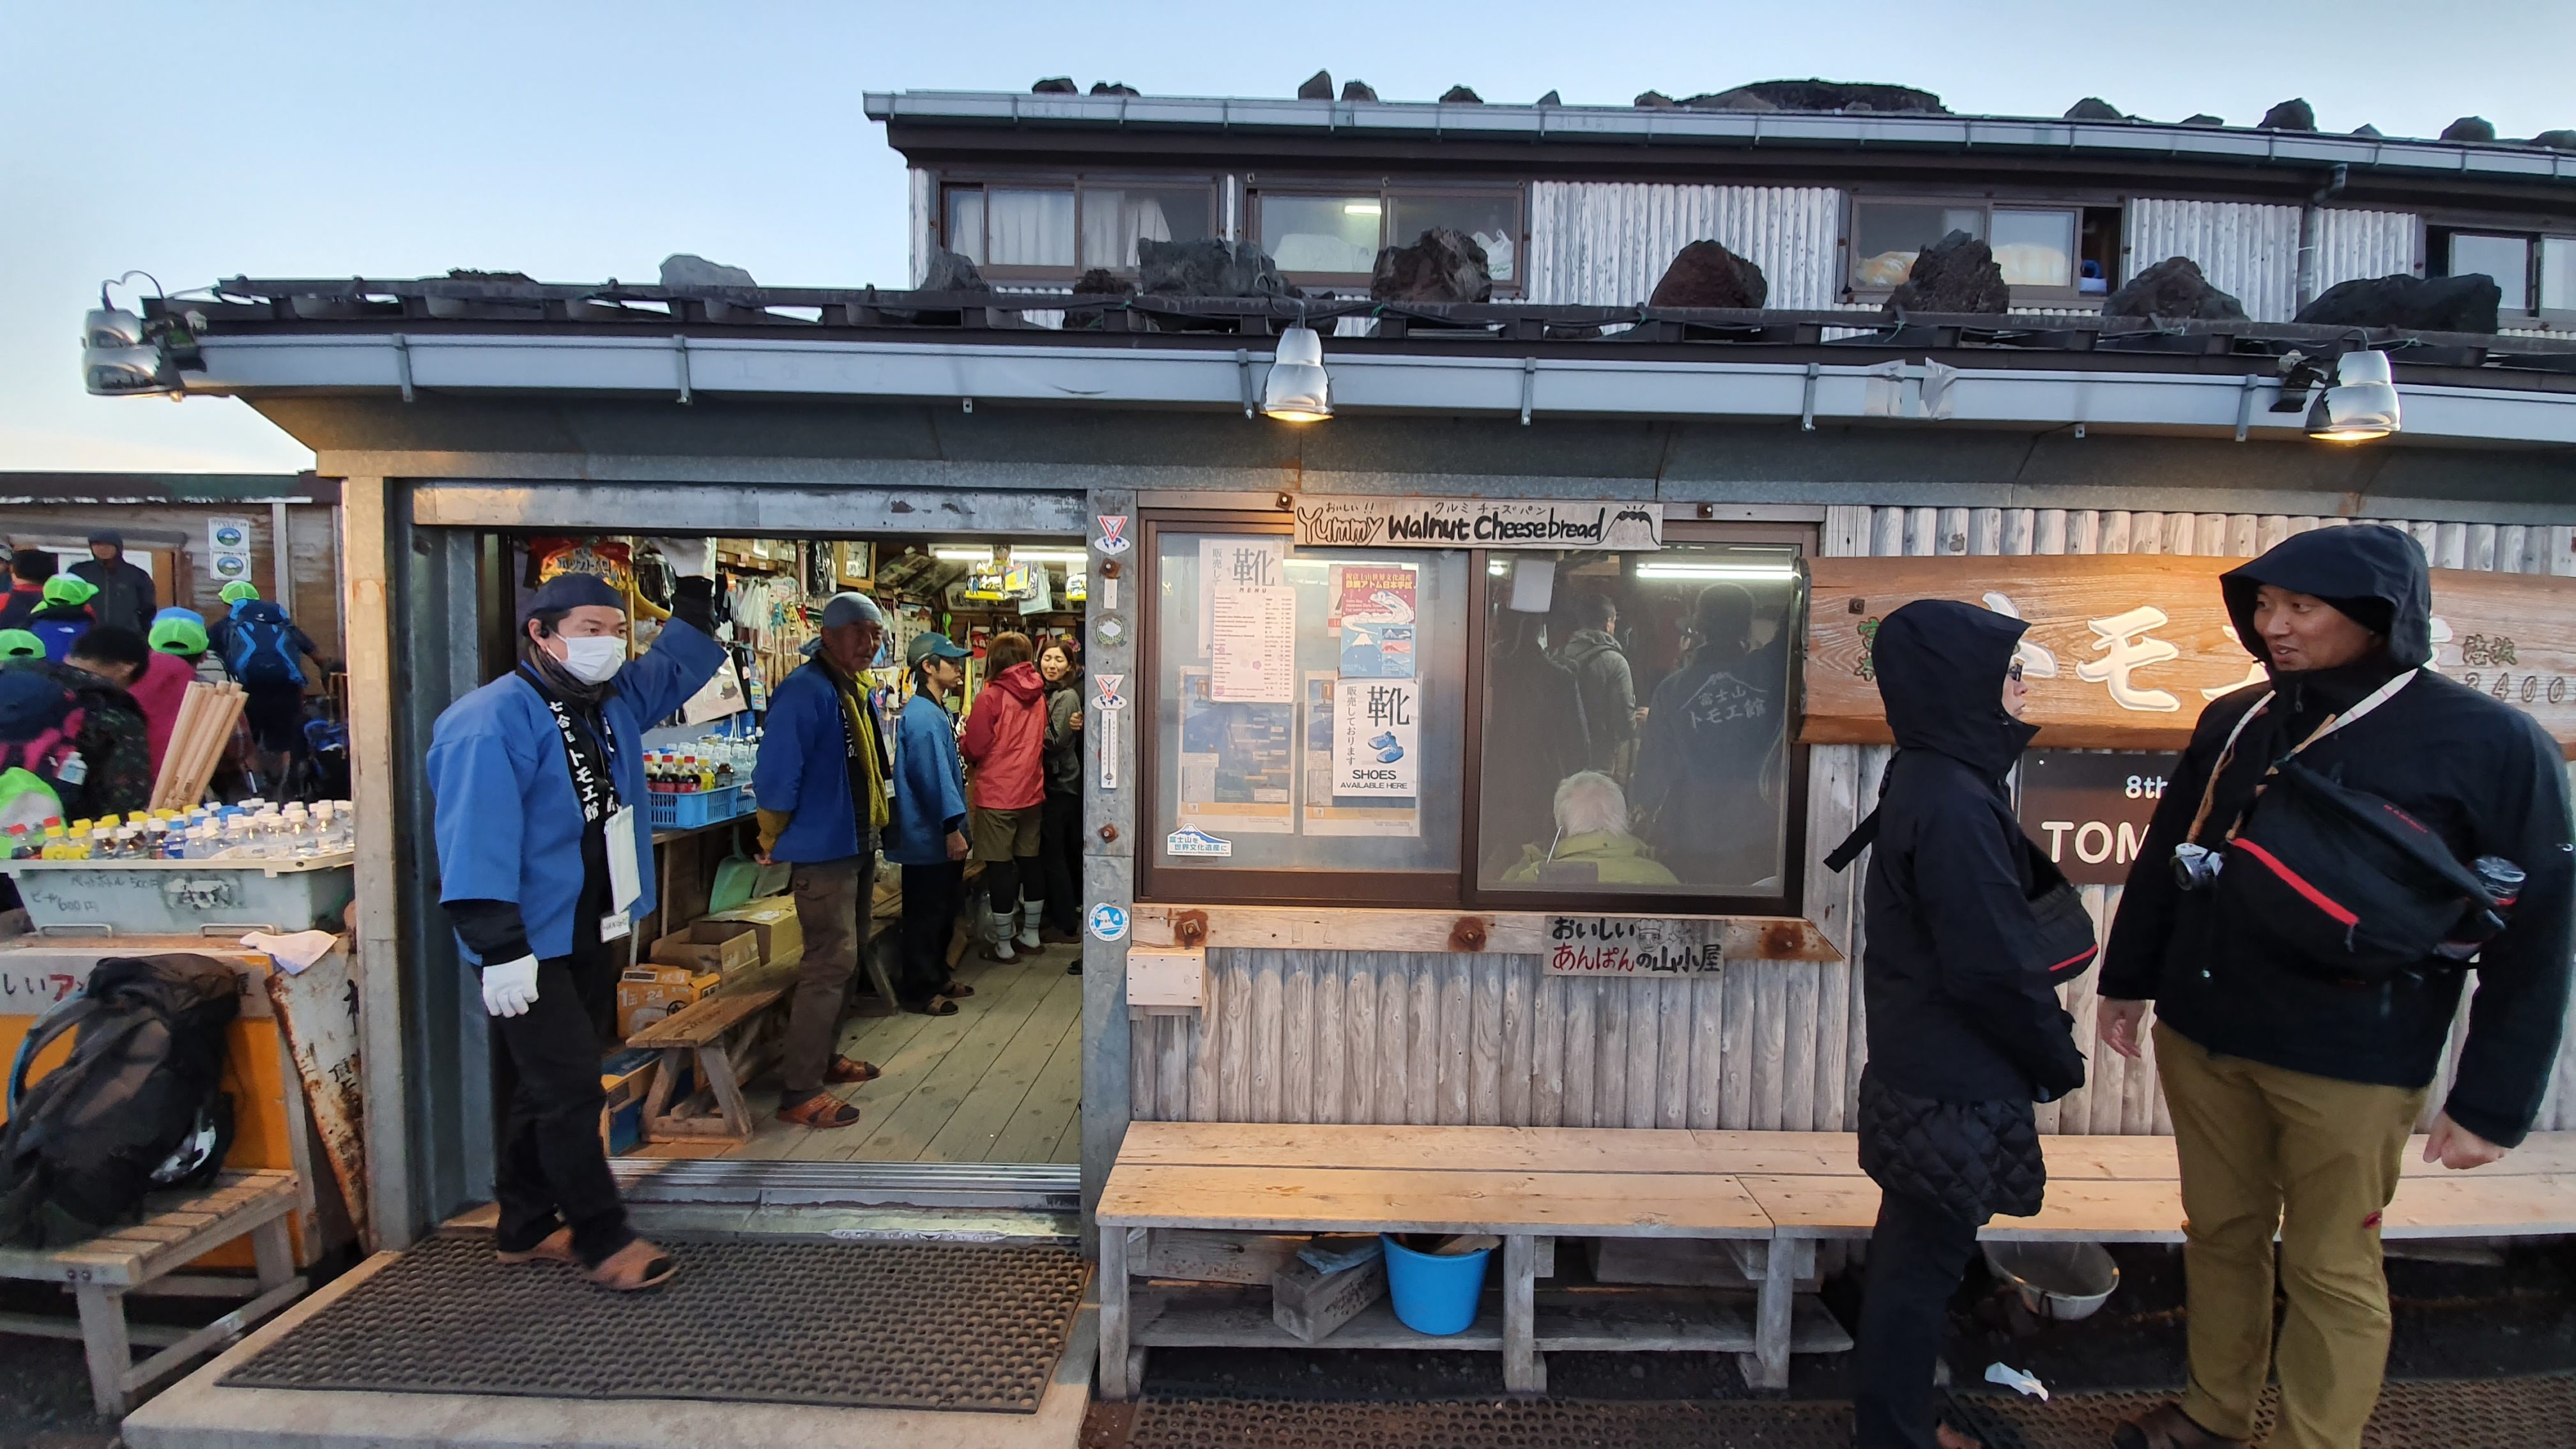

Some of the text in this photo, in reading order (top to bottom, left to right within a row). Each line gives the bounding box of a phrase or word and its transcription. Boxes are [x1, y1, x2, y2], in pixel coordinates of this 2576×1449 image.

[1326, 502, 1359, 512] おいしい
[1435, 502, 1469, 515] クルミ
[1478, 503, 1546, 515] チーズパン
[1298, 507, 1384, 546] Yummy
[1388, 511, 1470, 540] Walnut
[1232, 548, 1275, 586] 靴
[1367, 686, 1410, 727] 靴
[1699, 686, 1747, 706] 富士山
[1346, 686, 1357, 766] 販売しております
[1690, 698, 1765, 729] トモエ館
[1353, 769, 1397, 779] SHOES
[1552, 917, 1635, 941] おいしい
[1552, 942, 1722, 974] あんぱんの山小屋
